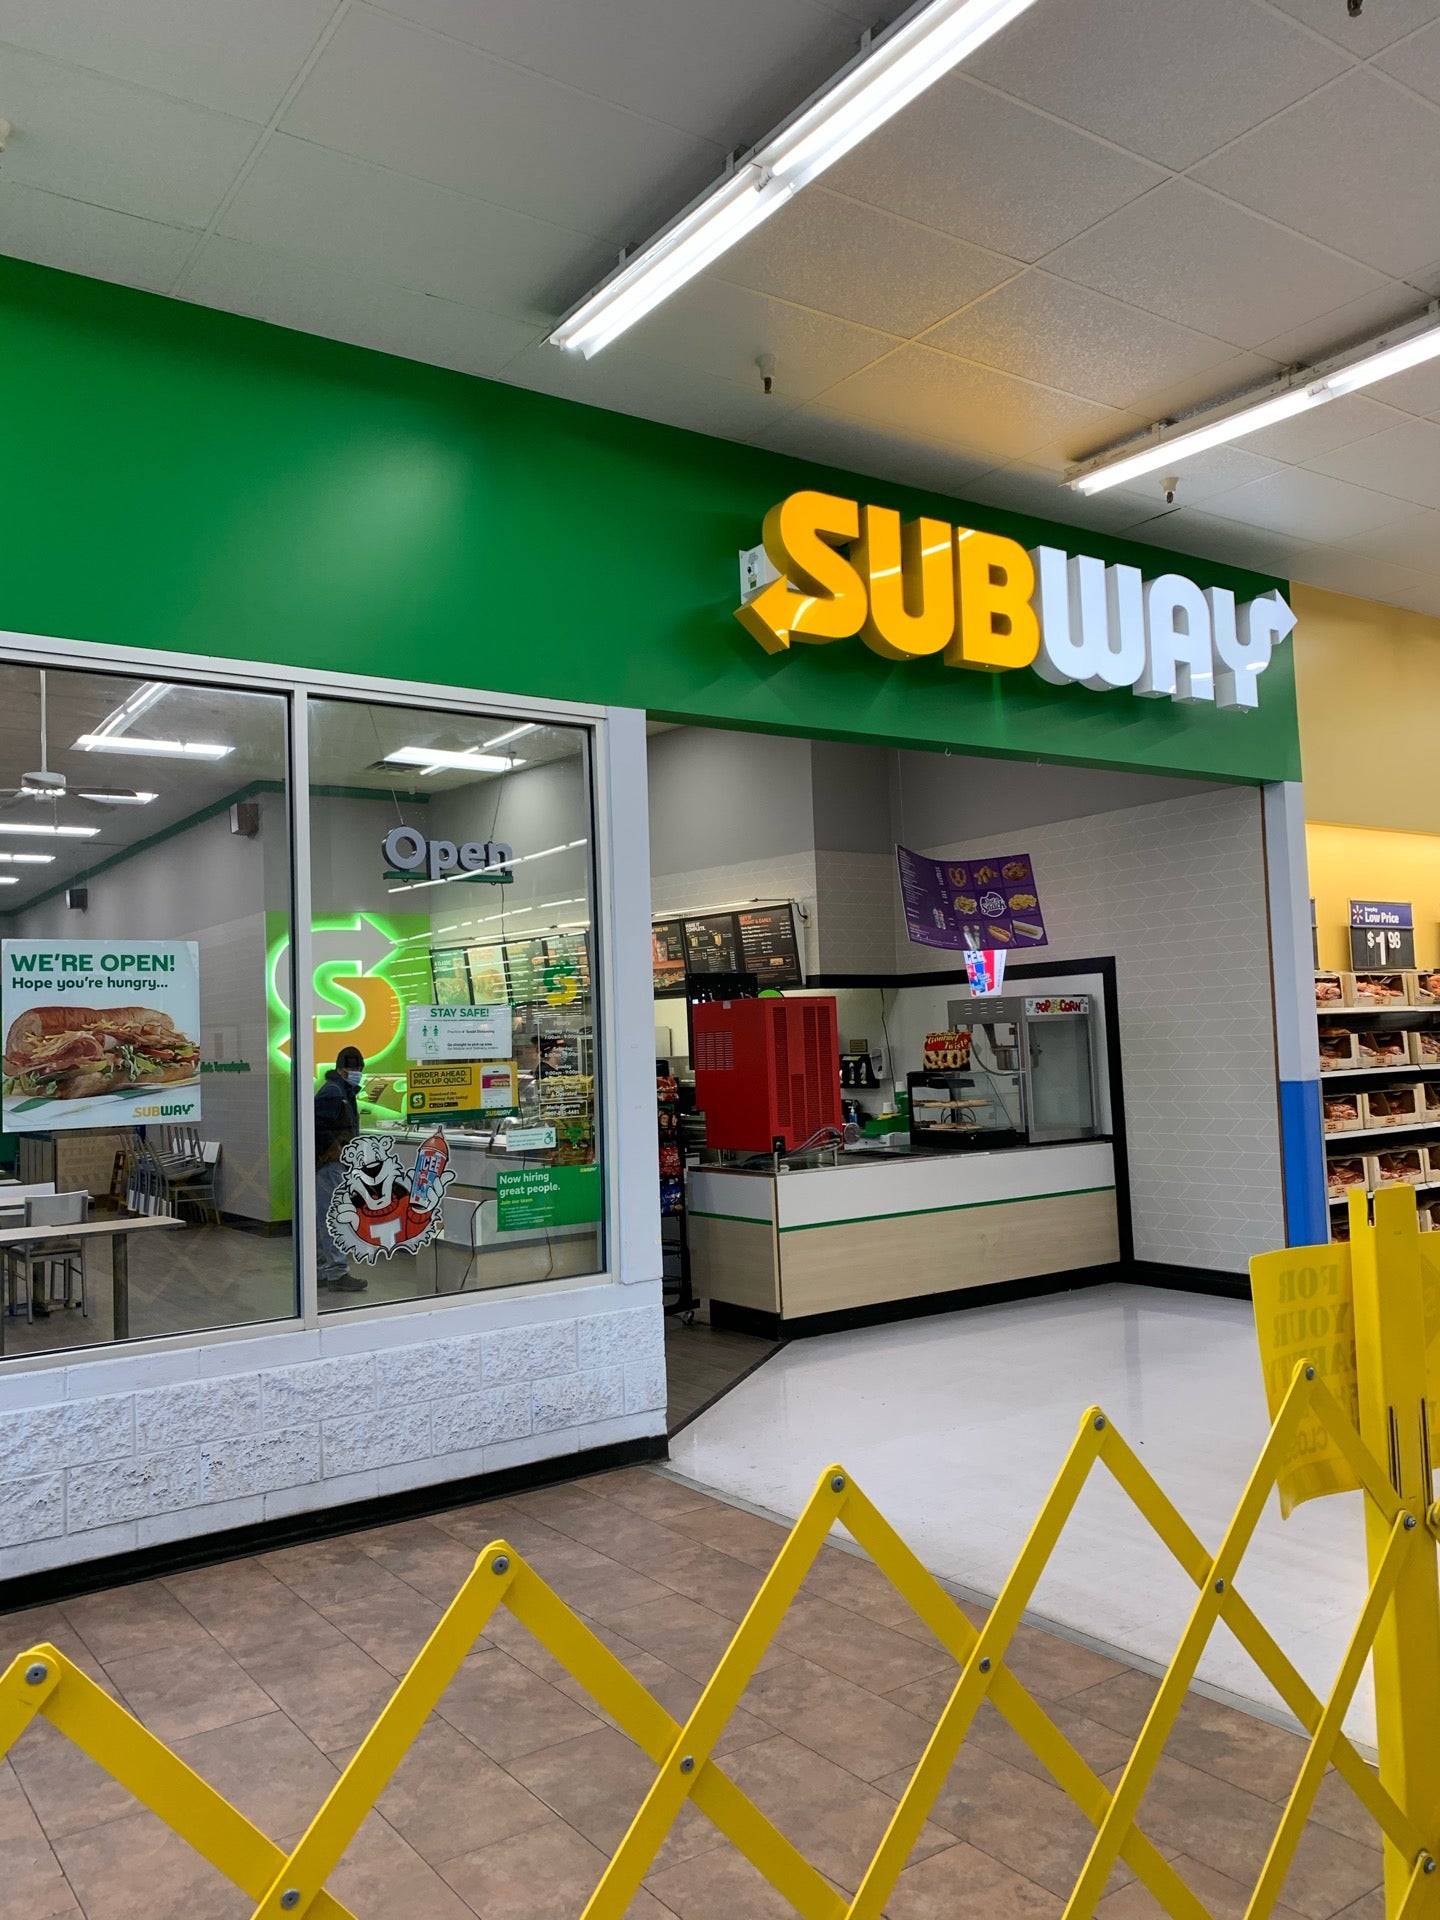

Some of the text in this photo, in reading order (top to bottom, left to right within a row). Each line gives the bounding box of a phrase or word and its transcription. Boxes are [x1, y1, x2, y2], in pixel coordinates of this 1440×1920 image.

[734, 490, 1298, 711] SUBWAY
[382, 825, 513, 880] Open
[1364, 911, 1400, 924] Low Price
[10, 953, 175, 972] WE'RE OPEN!
[12, 976, 168, 991] Hope you're hungry...
[430, 1008, 489, 1018] STAY SAFE!
[1035, 1001, 1051, 1014] POP
[413, 1070, 467, 1079] ORDER AHEAD.
[444, 1077, 467, 1085] QUICK.
[132, 1103, 195, 1118] SUBWAY
[420, 1156, 440, 1172] ICEE
[499, 1172, 549, 1185] Now hiring
[499, 1182, 560, 1199] great people.
